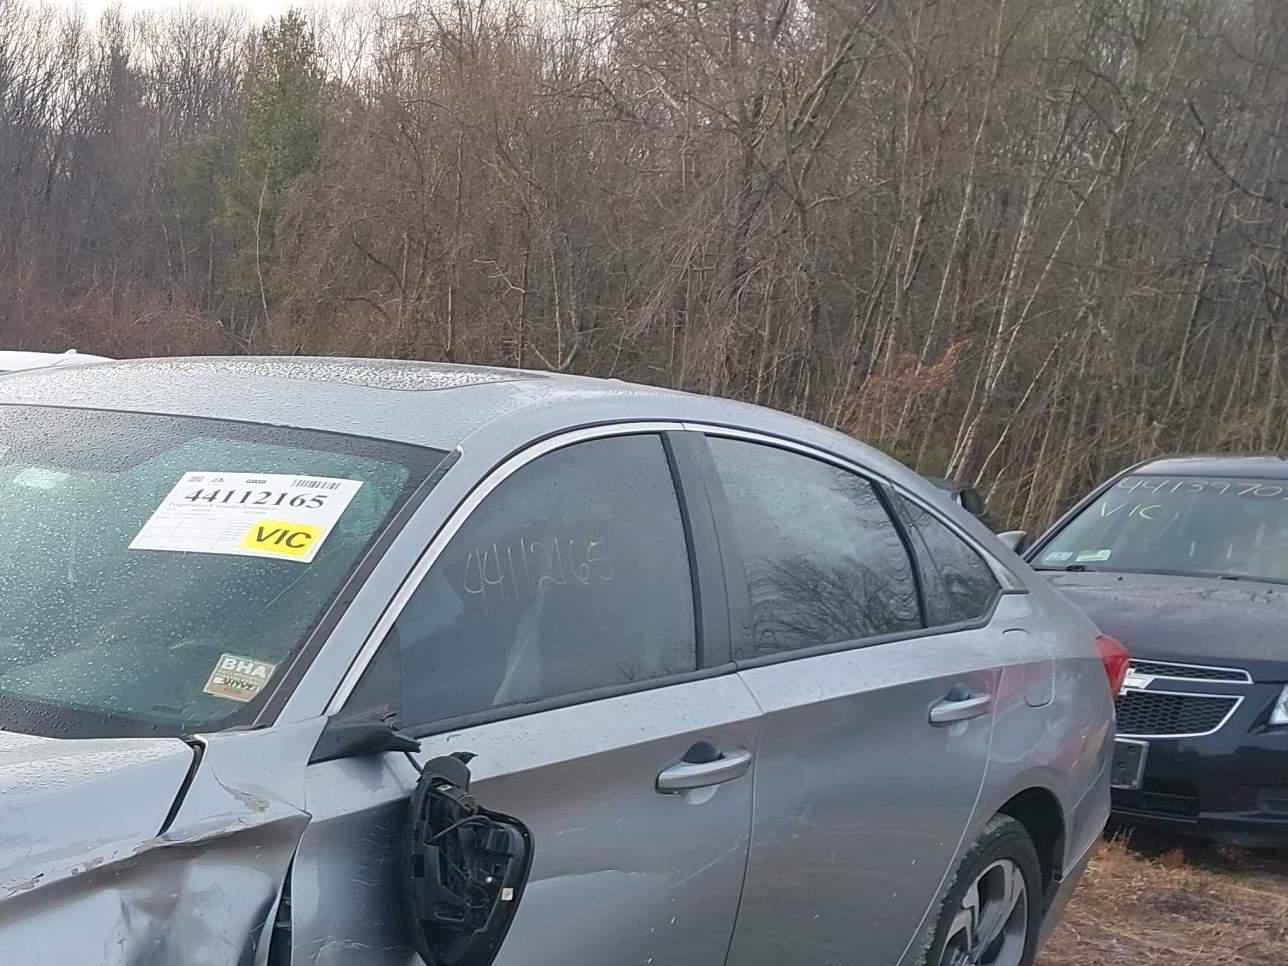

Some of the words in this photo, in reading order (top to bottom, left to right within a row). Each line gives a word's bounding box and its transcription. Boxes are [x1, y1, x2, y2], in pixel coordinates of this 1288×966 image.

[184, 488, 329, 509] 44112165
[1100, 501, 1164, 521] VIC
[255, 526, 312, 549] VIC
[463, 537, 615, 616] 44112165
[220, 656, 263, 677] BHA
